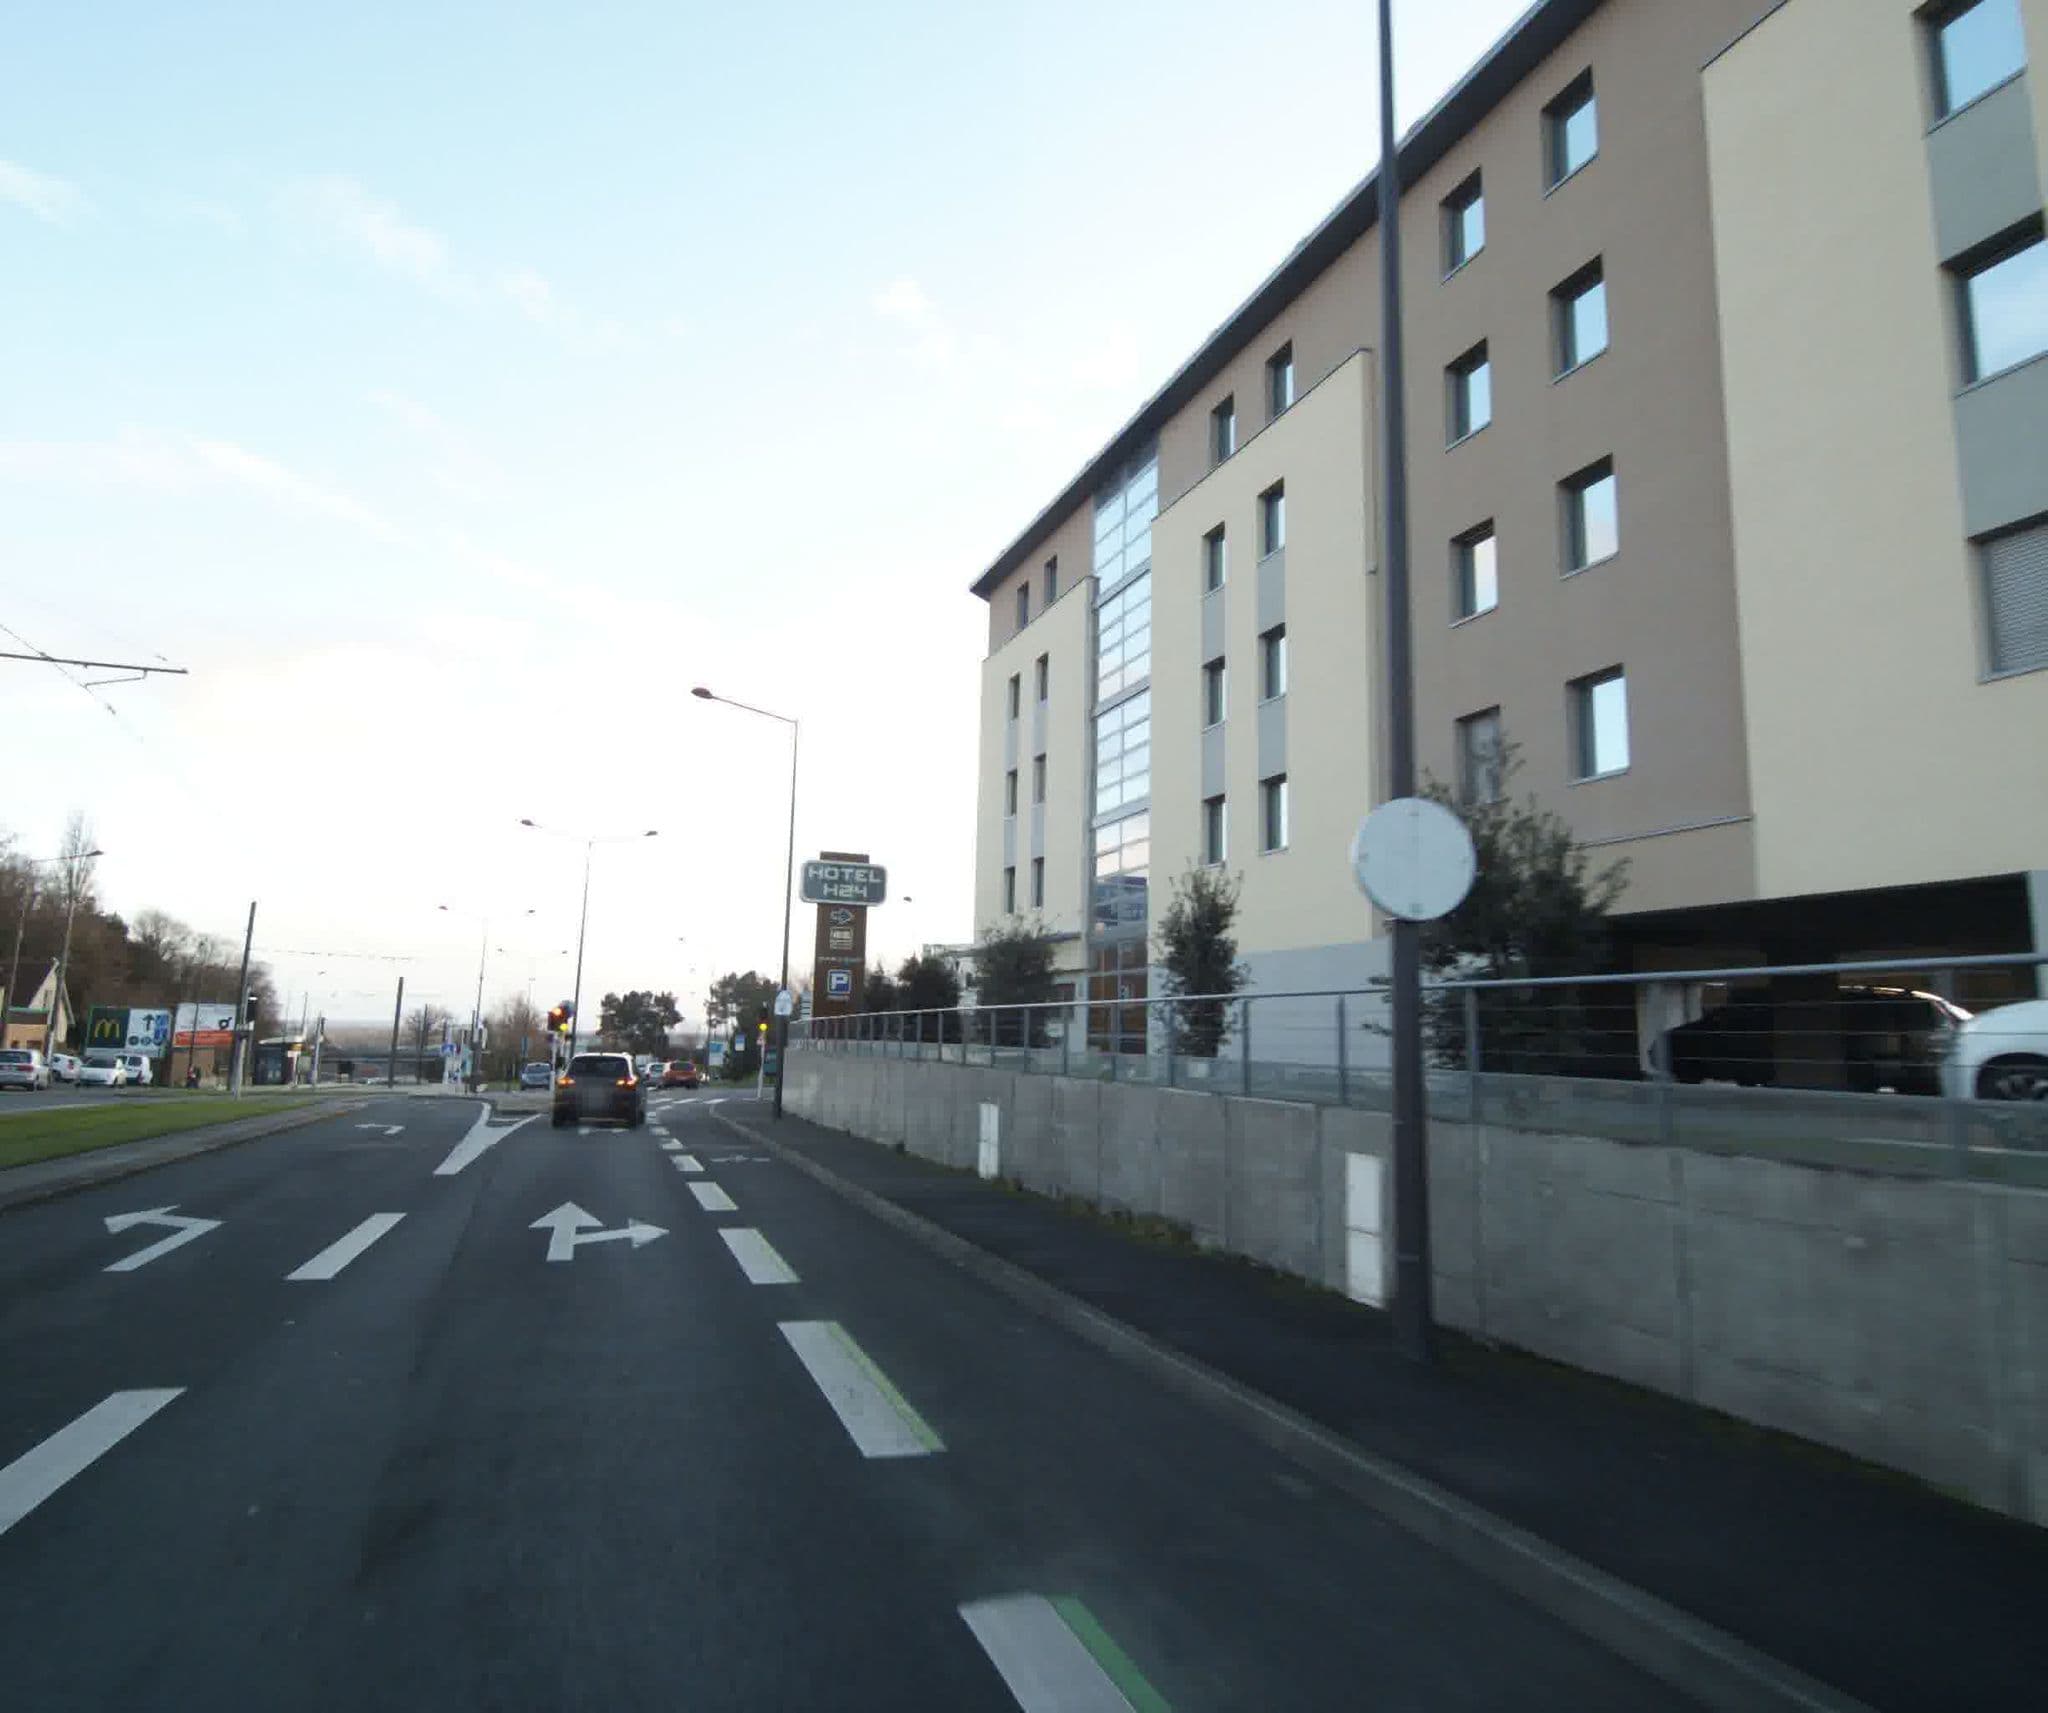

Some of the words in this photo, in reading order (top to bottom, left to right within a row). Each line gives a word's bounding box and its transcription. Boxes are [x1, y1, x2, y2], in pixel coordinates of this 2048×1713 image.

[808, 865, 881, 883] HOTEL
[823, 883, 867, 898] H24
[831, 973, 848, 990] P
